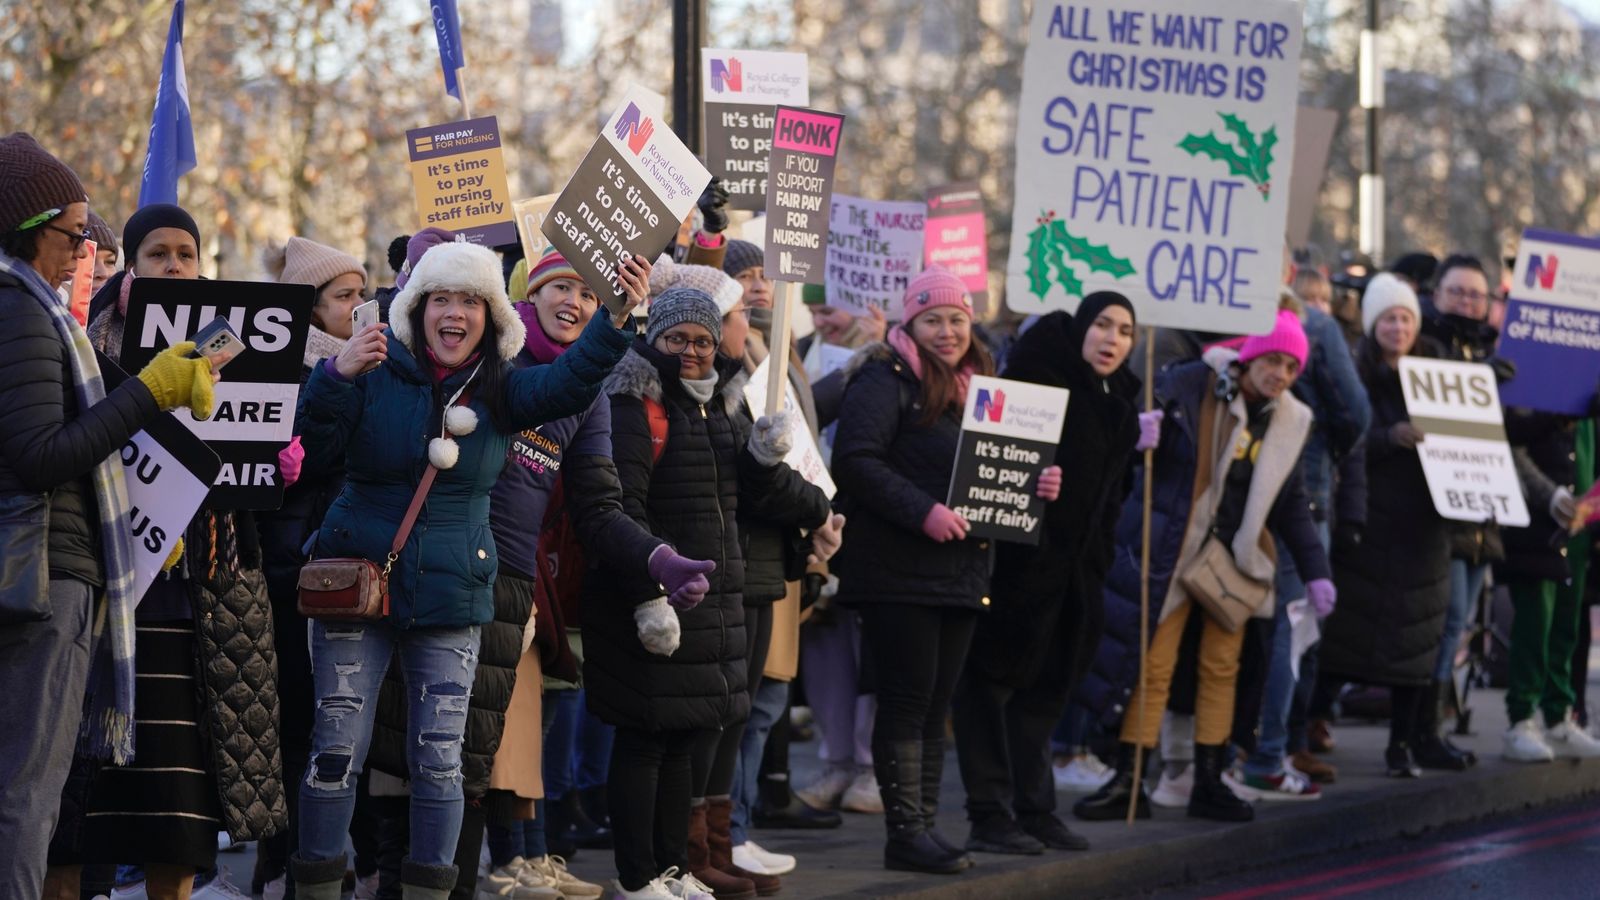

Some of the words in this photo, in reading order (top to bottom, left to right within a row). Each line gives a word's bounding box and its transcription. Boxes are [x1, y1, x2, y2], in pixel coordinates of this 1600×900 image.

[1047, 4, 1099, 42] ALL
[1108, 8, 1144, 46] WE
[1152, 13, 1223, 52] WANT
[1234, 19, 1289, 60] FOR
[1068, 50, 1229, 99] CHRISTMAS
[1235, 65, 1267, 102] IS
[722, 112, 749, 128] It's
[1042, 96, 1154, 164] SAFE
[434, 132, 455, 142] FAIR
[456, 129, 474, 139] PAY
[435, 140, 454, 149] FOR
[455, 133, 494, 146] NURSING
[730, 135, 750, 150] to
[779, 117, 835, 148] HONK
[427, 163, 451, 177] It's
[454, 158, 489, 172] time
[648, 143, 669, 170] Royal
[667, 165, 693, 197] College
[786, 154, 796, 169] IF
[797, 155, 820, 174] YOU
[437, 180, 453, 190] to
[457, 175, 484, 190] pay
[641, 156, 652, 168] of
[649, 164, 677, 200] Nursing
[776, 172, 825, 194] SUPPORT
[434, 188, 492, 206] nursing
[602, 158, 626, 189] It's
[626, 184, 660, 228] time
[775, 191, 800, 208] FAIR
[801, 194, 823, 212] PAY
[1070, 165, 1244, 237] PATIENT
[427, 205, 462, 223] staff
[465, 201, 504, 217] fairly
[595, 185, 612, 208] to
[611, 207, 642, 241] pay
[786, 211, 808, 229] FOR
[874, 211, 924, 231] NURSES
[554, 210, 592, 253] staff
[577, 201, 633, 267] nursing
[773, 228, 820, 249] NURSING
[830, 264, 907, 292] PROBLEM
[1146, 239, 1258, 311] CARE
[1519, 304, 1551, 325] THE
[1553, 310, 1600, 332] VOICE
[1507, 321, 1532, 340] OF
[1407, 367, 1493, 410] NHS
[190, 401, 283, 423] ARE
[513, 440, 560, 471] STAFFING
[515, 454, 545, 474] LIVES
[975, 440, 1000, 459] It's
[1003, 444, 1040, 464] time
[1424, 448, 1505, 467] HUMANITY
[978, 463, 996, 480] to
[998, 468, 1030, 487] pay
[968, 486, 1030, 510] nursing
[1445, 489, 1509, 515] BEST
[953, 505, 994, 523] staff
[995, 508, 1038, 532] fairly
